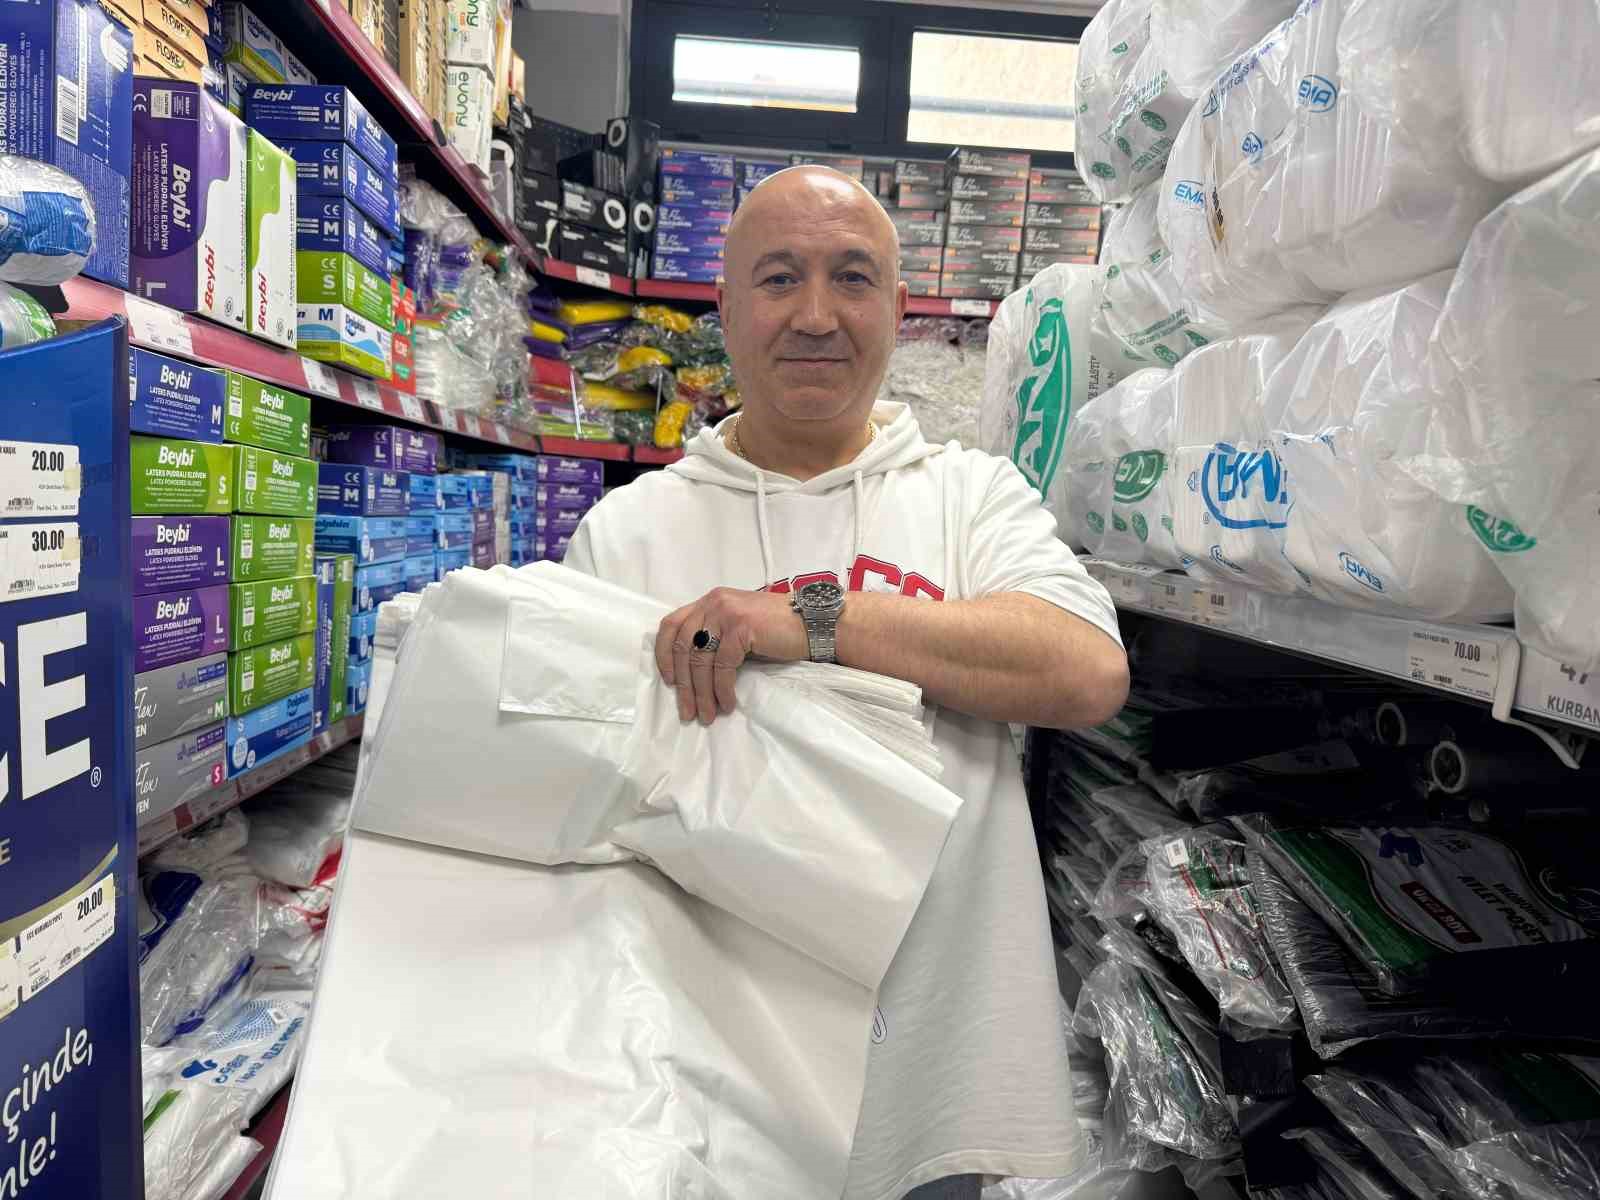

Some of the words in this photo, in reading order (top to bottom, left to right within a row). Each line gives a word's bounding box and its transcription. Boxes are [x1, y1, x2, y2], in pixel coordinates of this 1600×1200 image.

[253, 88, 293, 101] Beybi
[456, 71, 469, 128] evony
[324, 109, 340, 124] M
[323, 165, 338, 180] M
[170, 163, 191, 232] Beybi
[323, 222, 339, 236] M
[204, 246, 215, 312] Beybi
[322, 275, 335, 289] S
[146, 281, 166, 297] L
[258, 273, 268, 332] Beybi
[318, 308, 334, 321] M
[160, 364, 192, 390] Beybi
[260, 389, 285, 410] Beybi
[211, 404, 222, 425] M
[301, 422, 308, 439] S
[31, 450, 65, 472] 20.00
[159, 446, 194, 467] Beybi
[375, 444, 386, 459] L
[272, 458, 294, 476] Beybi
[218, 475, 226, 495] S
[308, 486, 314, 503] S
[343, 487, 360, 502] M
[31, 529, 65, 552] 30.00
[156, 523, 190, 545] Beybi
[269, 523, 291, 539] Beybi
[216, 547, 225, 567] L
[271, 585, 293, 602] Beybi
[156, 597, 190, 620] Beybi
[306, 601, 312, 617] S
[215, 615, 224, 634] L
[269, 644, 292, 664] Beybi
[1454, 641, 1481, 662] 70.00
[307, 657, 313, 673] S
[214, 700, 224, 718] M
[238, 719, 244, 733] S
[214, 765, 220, 784] S
[77, 887, 103, 921] 20.00
